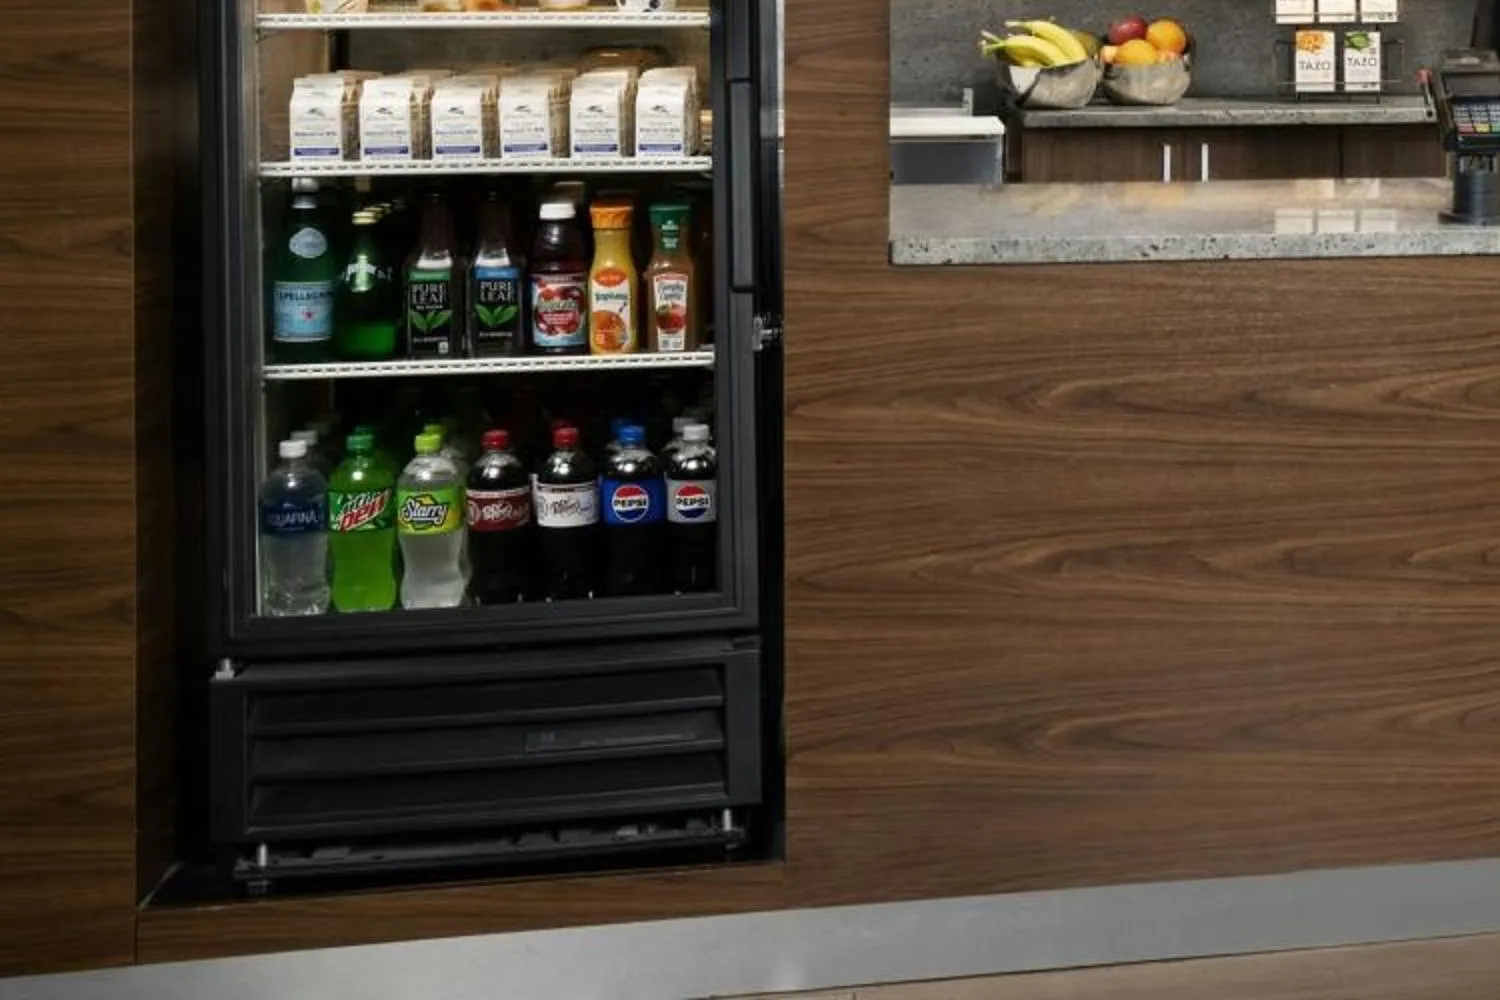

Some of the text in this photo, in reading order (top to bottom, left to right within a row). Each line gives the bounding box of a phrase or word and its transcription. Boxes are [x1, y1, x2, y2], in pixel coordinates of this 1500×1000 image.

[1299, 60, 1332, 71] TAZO
[1346, 57, 1377, 67] TAZO
[676, 497, 708, 506] PEPSI
[402, 500, 448, 525] Starry
